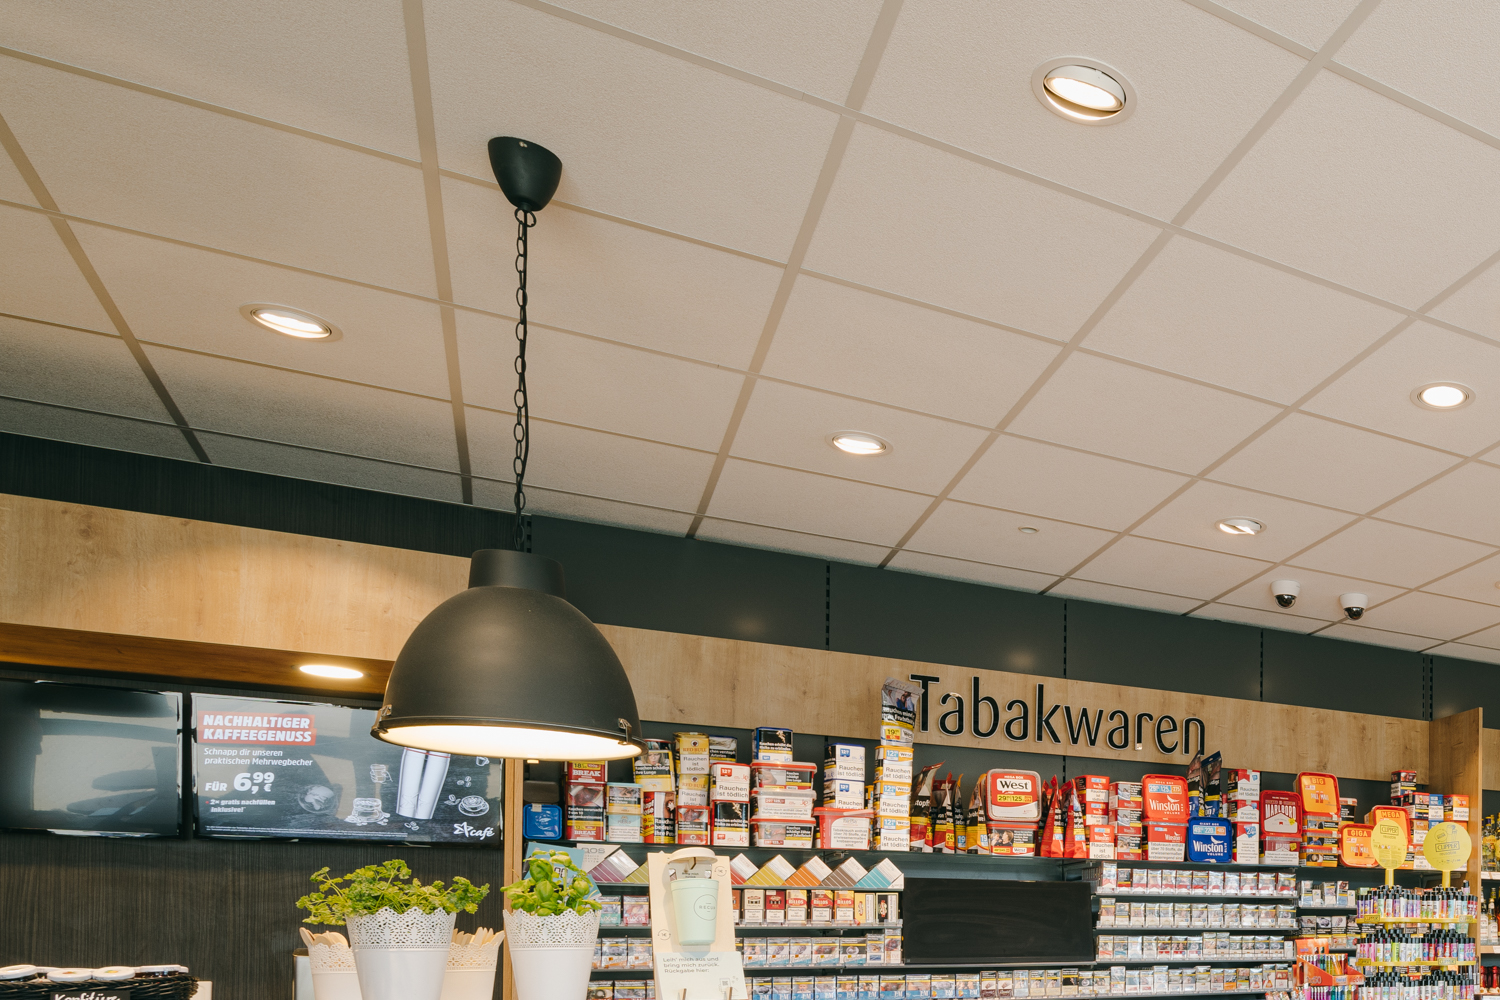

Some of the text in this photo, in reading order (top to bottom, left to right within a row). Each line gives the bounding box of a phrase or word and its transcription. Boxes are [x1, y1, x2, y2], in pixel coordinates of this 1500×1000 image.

[909, 673, 1206, 756] Tabakwaren
[203, 714, 310, 729] NACHHALTIGER
[203, 728, 312, 742] KAFFEEGENUSS
[204, 747, 283, 757] Schnapp dir unseren
[204, 757, 313, 767] praktischen Mehrwegbecher
[205, 781, 227, 792] FÜR
[1000, 780, 1029, 790] West
[1149, 799, 1180, 811] Winston
[470, 827, 495, 840] café
[1193, 840, 1224, 853] Winston
[1436, 843, 1459, 851] CLIPPER
